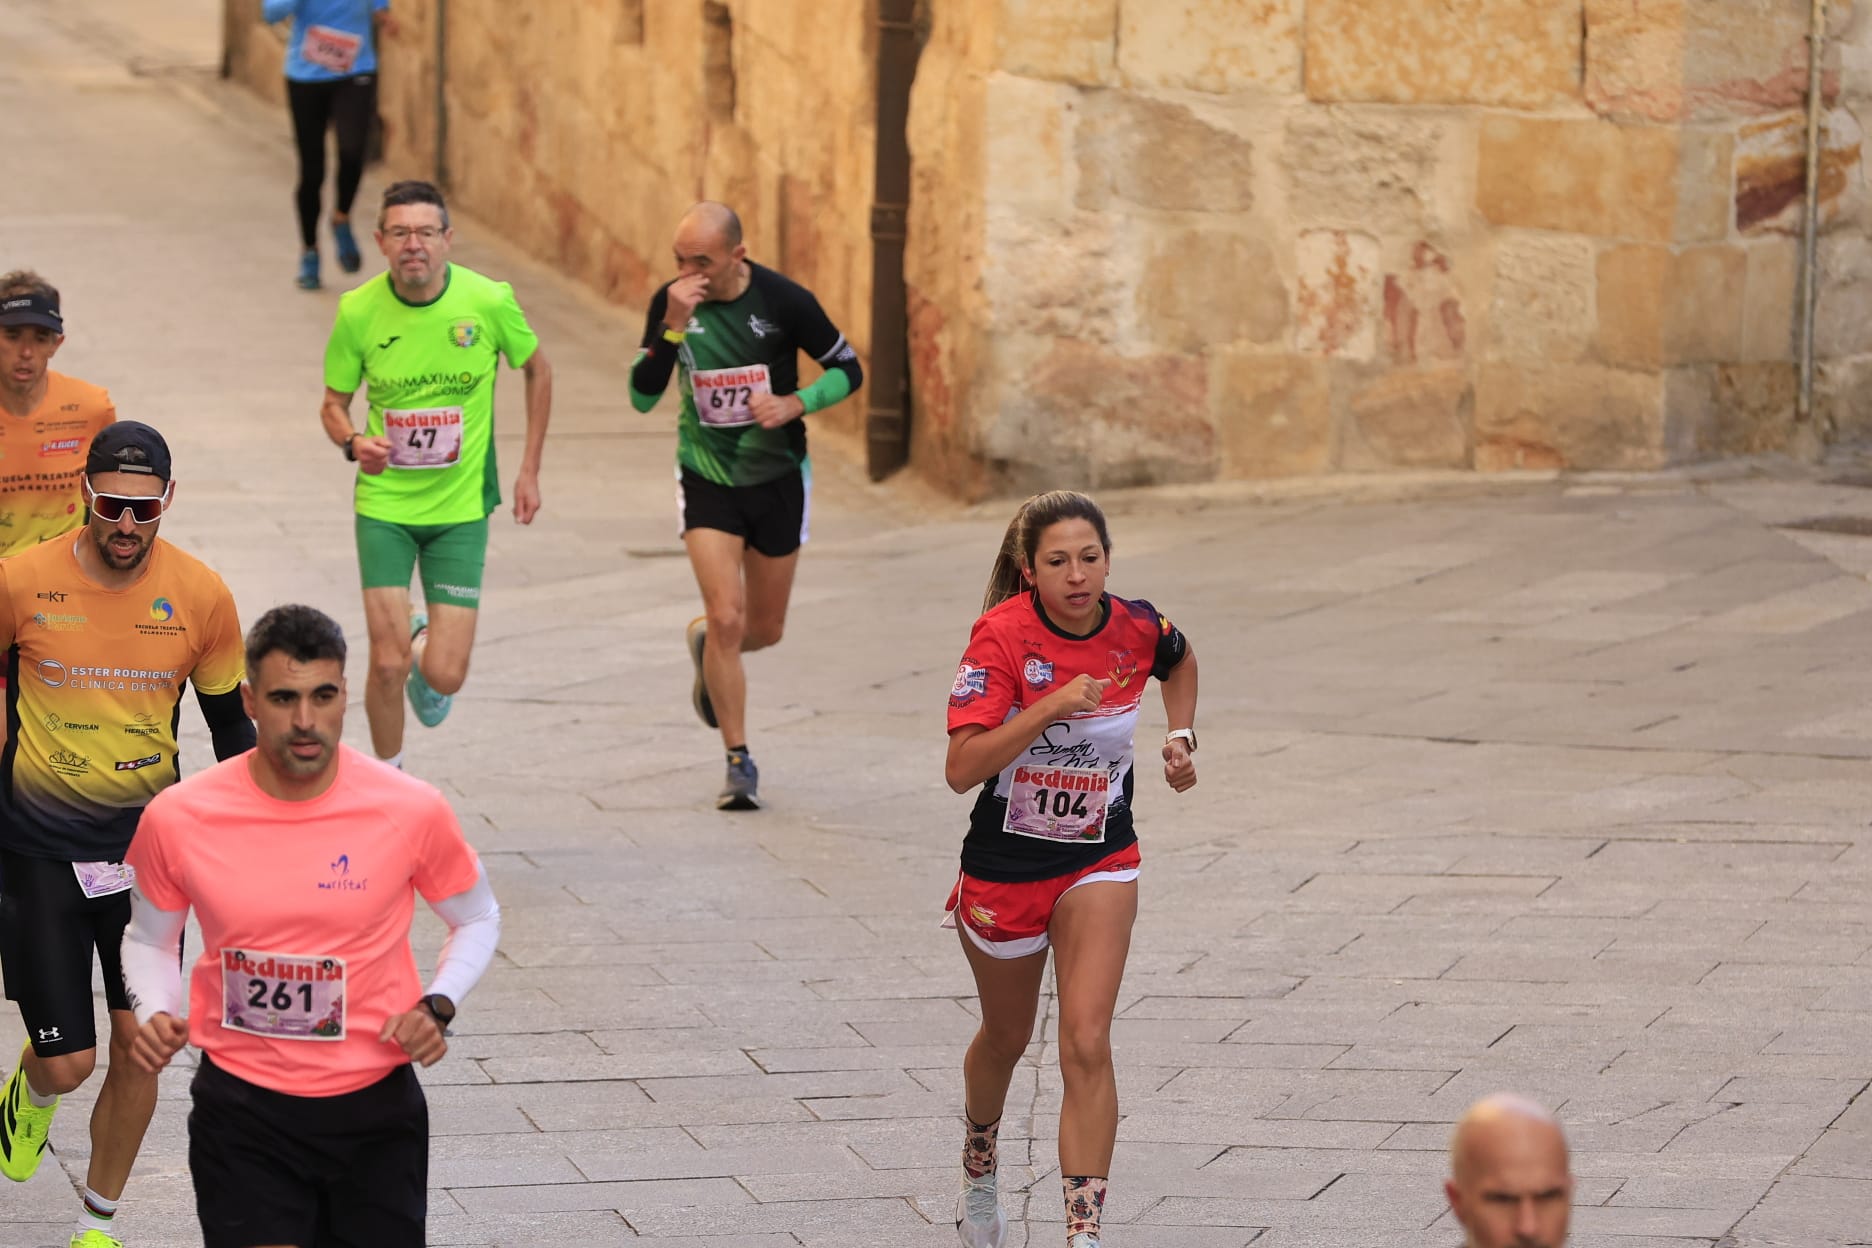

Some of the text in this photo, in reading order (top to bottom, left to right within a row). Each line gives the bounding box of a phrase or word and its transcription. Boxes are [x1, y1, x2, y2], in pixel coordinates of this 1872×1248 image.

[693, 370, 766, 387] bedunia
[710, 387, 752, 409] 672
[385, 411, 460, 428] bedunia
[407, 428, 437, 449] 47
[71, 667, 110, 677] ESTER
[70, 678, 125, 689] CLÍNICA
[1030, 722, 1095, 756] Simón
[1013, 767, 1109, 792] bedunia
[1034, 788, 1088, 819] 104
[318, 878, 368, 891] maristas
[225, 951, 343, 982] bedunia
[248, 979, 313, 1012] 261
